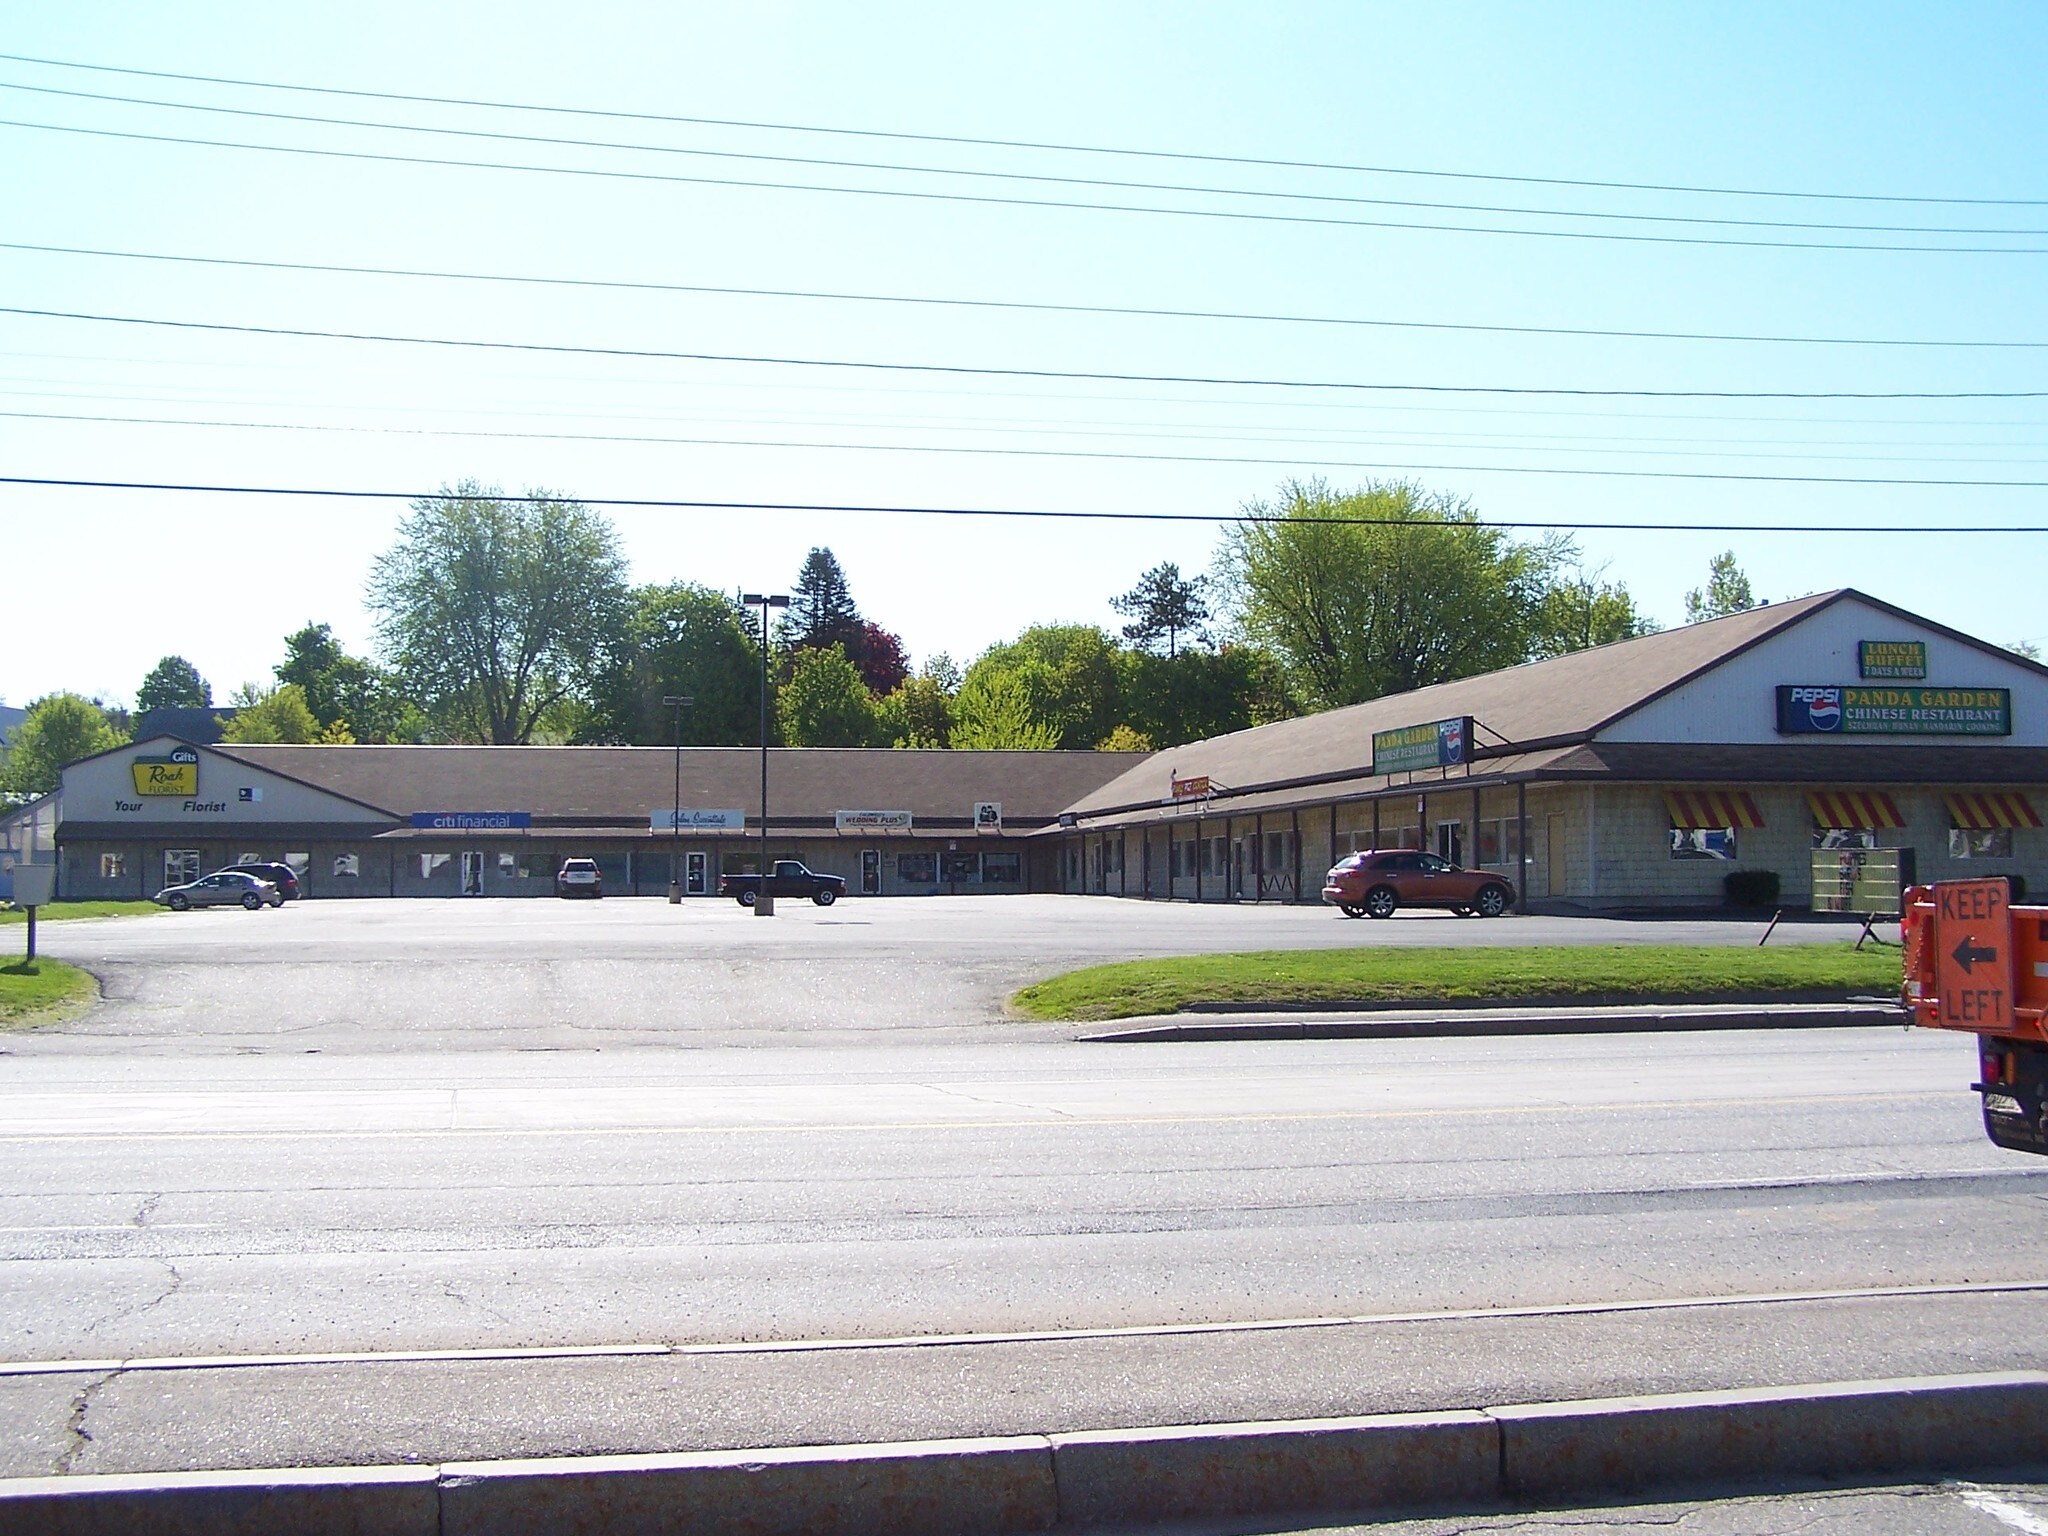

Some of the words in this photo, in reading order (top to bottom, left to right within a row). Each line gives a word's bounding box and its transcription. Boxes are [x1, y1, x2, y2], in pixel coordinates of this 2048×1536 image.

[1868, 643, 1920, 654] LUNCH
[1865, 655, 1922, 666] BUFFET
[1864, 666, 1870, 675] 7
[1871, 666, 1892, 676] DAYS
[1893, 667, 1899, 676] A
[1900, 667, 1924, 676] WEEK
[1790, 688, 1840, 703] PEPSI
[1845, 690, 1914, 706] PANDA
[1920, 691, 2001, 707] GARDEN
[1846, 708, 1907, 719] CHINESE
[1912, 708, 2001, 721] RESTAURANT
[1375, 733, 1402, 749] PANDA
[1404, 726, 1438, 744] GARDEN
[172, 752, 197, 762] Gifts
[149, 785, 184, 793] FLORIST
[115, 801, 143, 812] Your
[183, 801, 226, 812] Florist
[1940, 887, 2003, 921] KEEP
[1946, 989, 2004, 1022] LEFT
